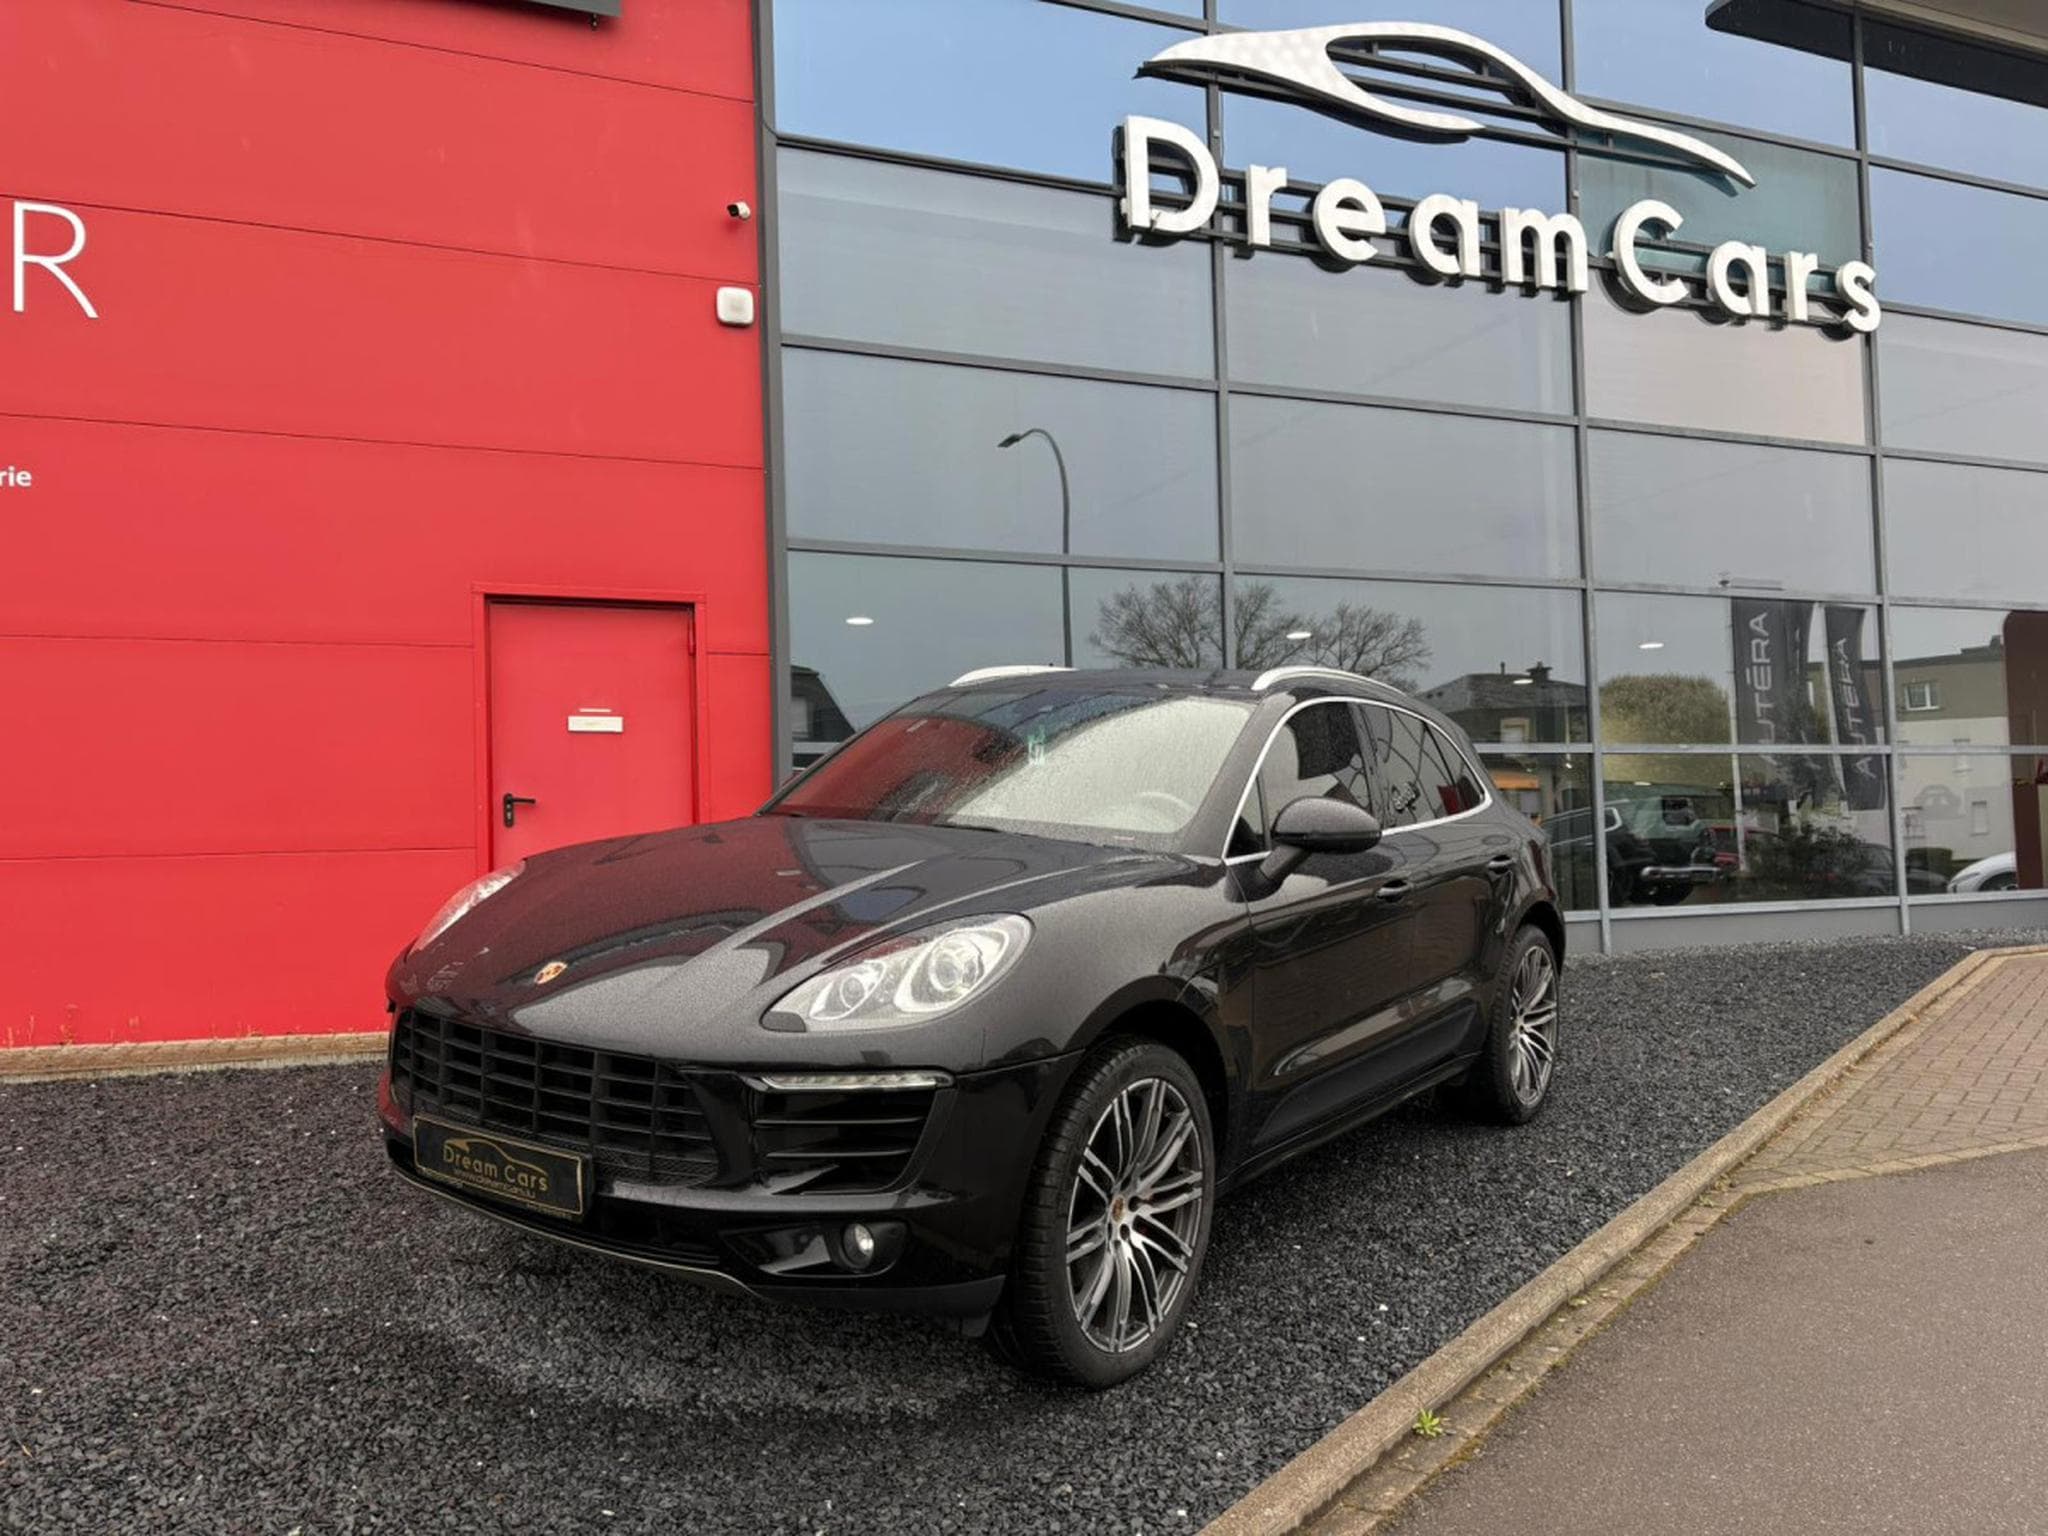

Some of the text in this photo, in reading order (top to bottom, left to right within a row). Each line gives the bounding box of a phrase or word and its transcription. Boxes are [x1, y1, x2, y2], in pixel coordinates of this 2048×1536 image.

[13, 200, 99, 318] R
[1120, 114, 1882, 333] Dream Cars
[443, 1144, 498, 1178] Dream
[504, 1165, 548, 1191] Cars
